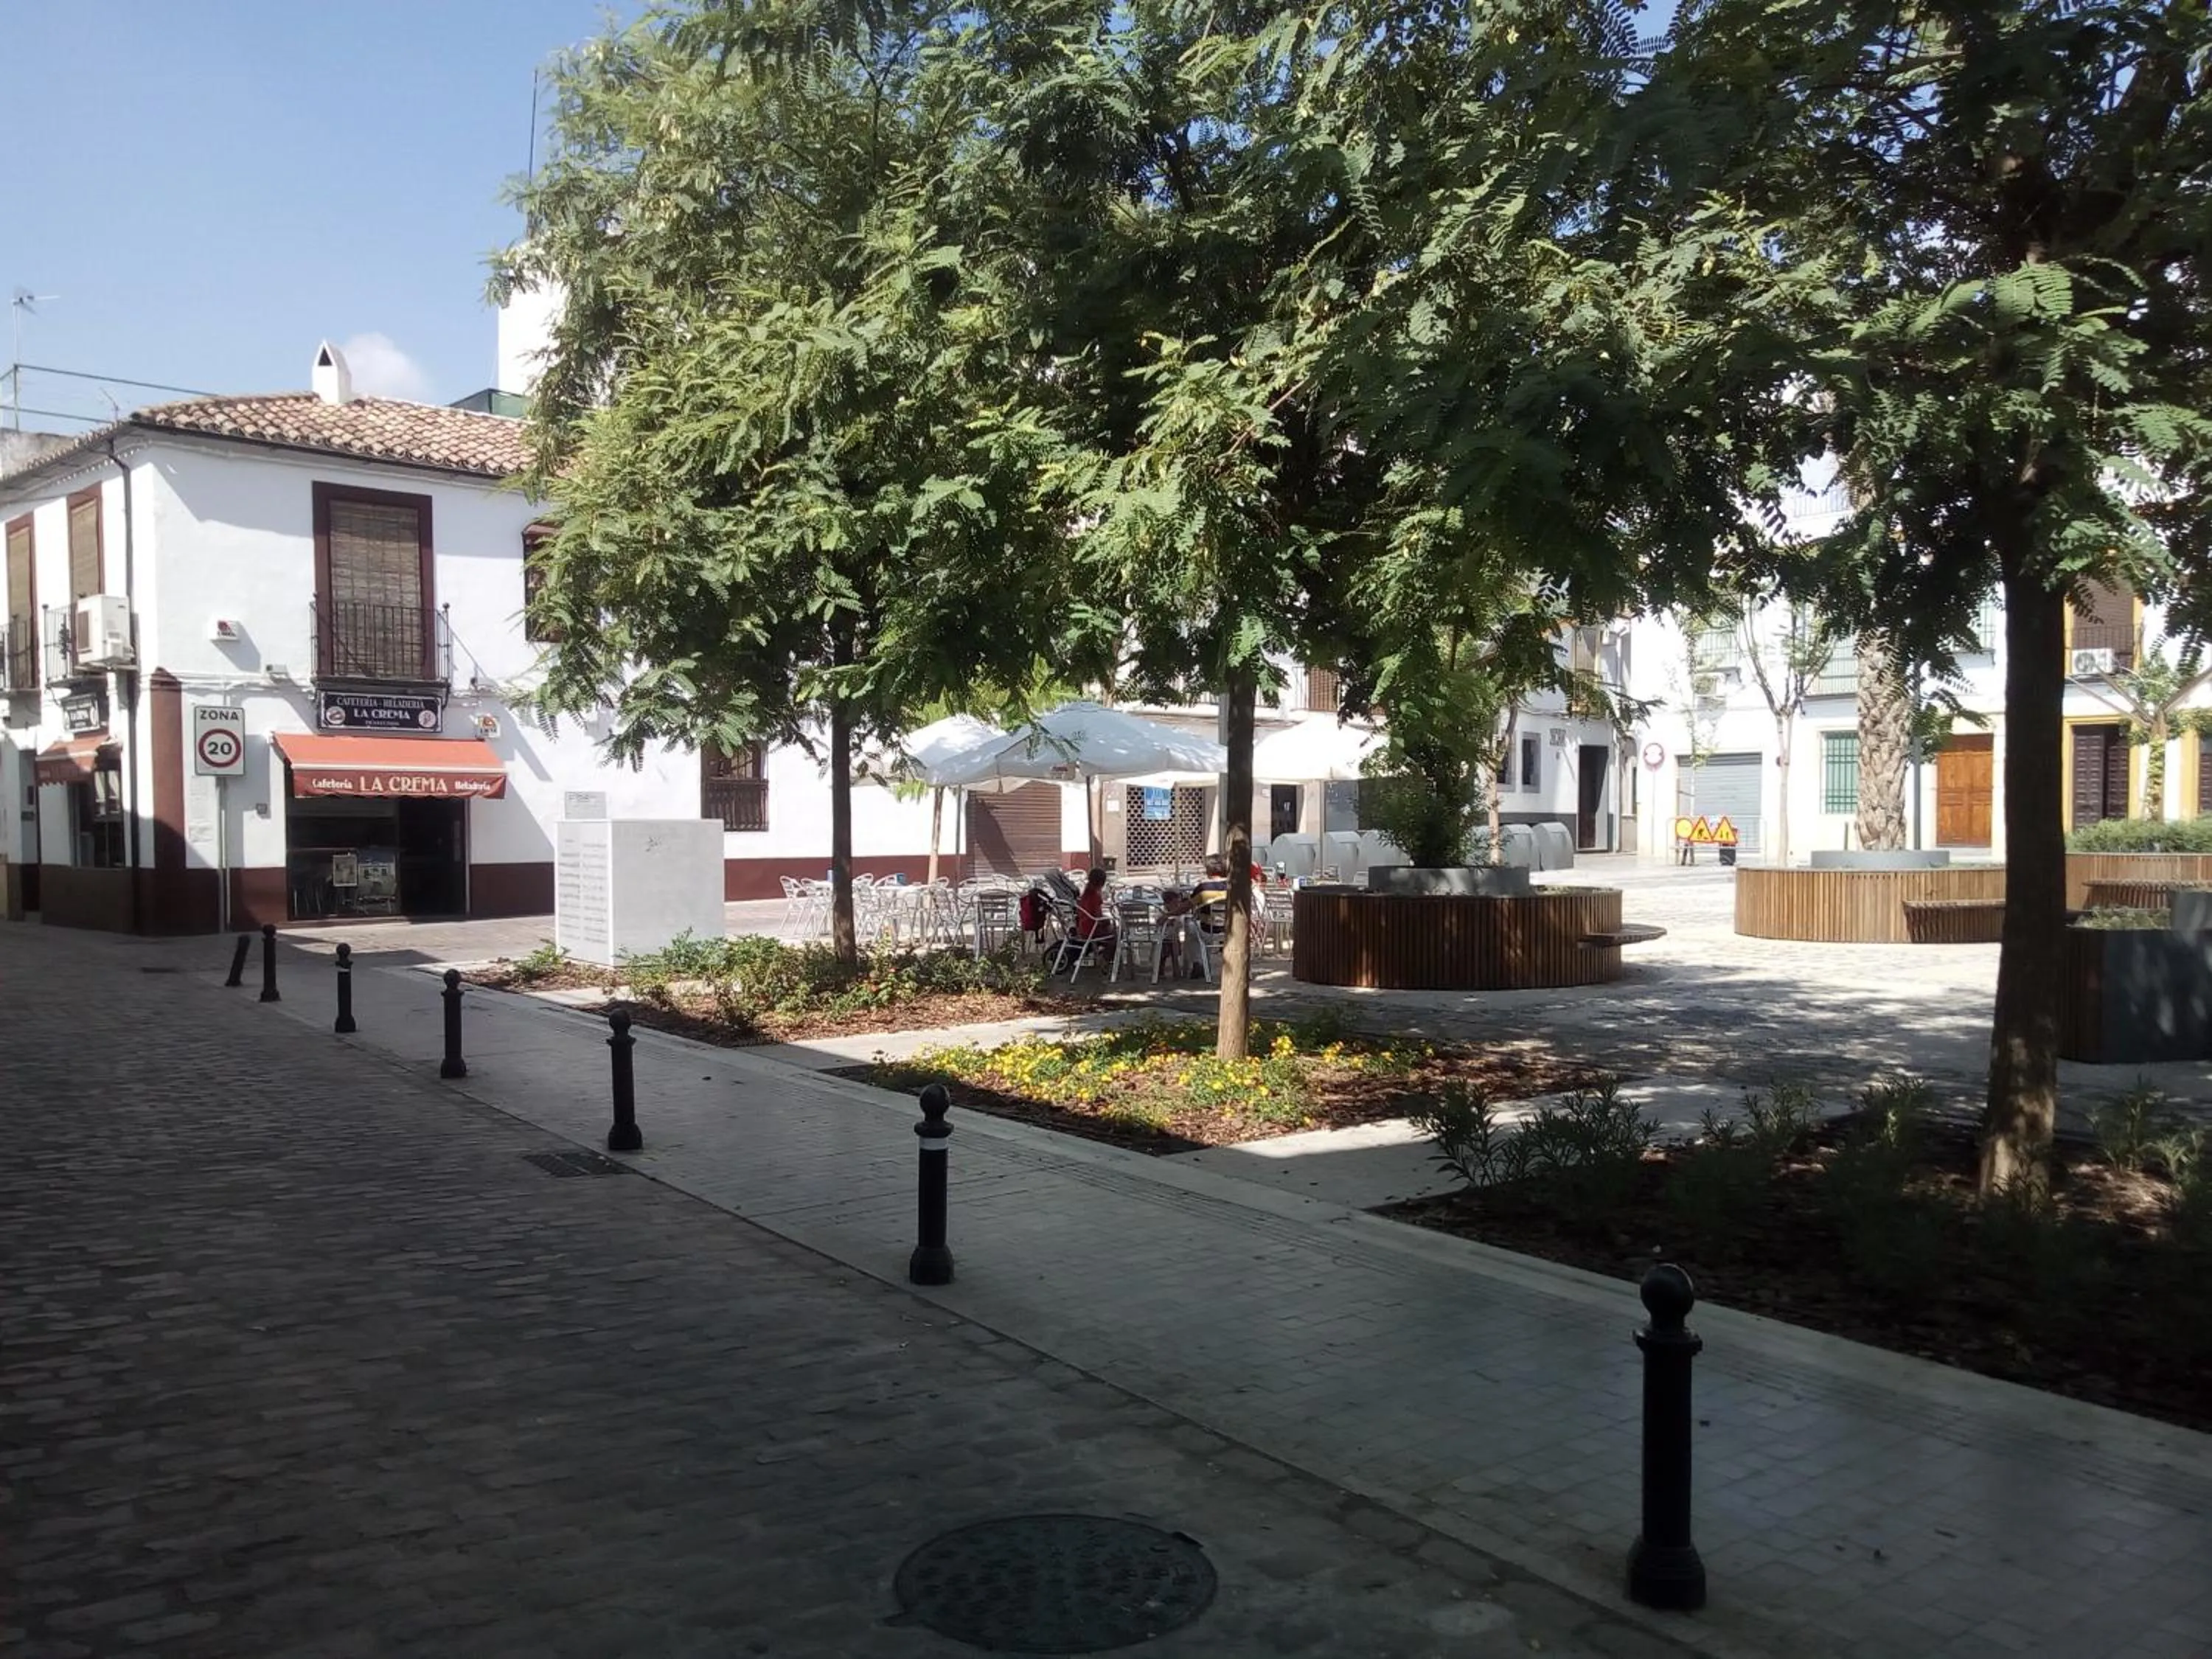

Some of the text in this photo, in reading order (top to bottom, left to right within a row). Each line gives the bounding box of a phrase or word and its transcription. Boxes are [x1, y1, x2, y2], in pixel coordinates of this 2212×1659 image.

[200, 709, 240, 720] ZONA
[353, 708, 411, 720] LA CREMA
[208, 741, 232, 755] 20
[360, 776, 383, 791] LA
[388, 776, 448, 792] CREMA
